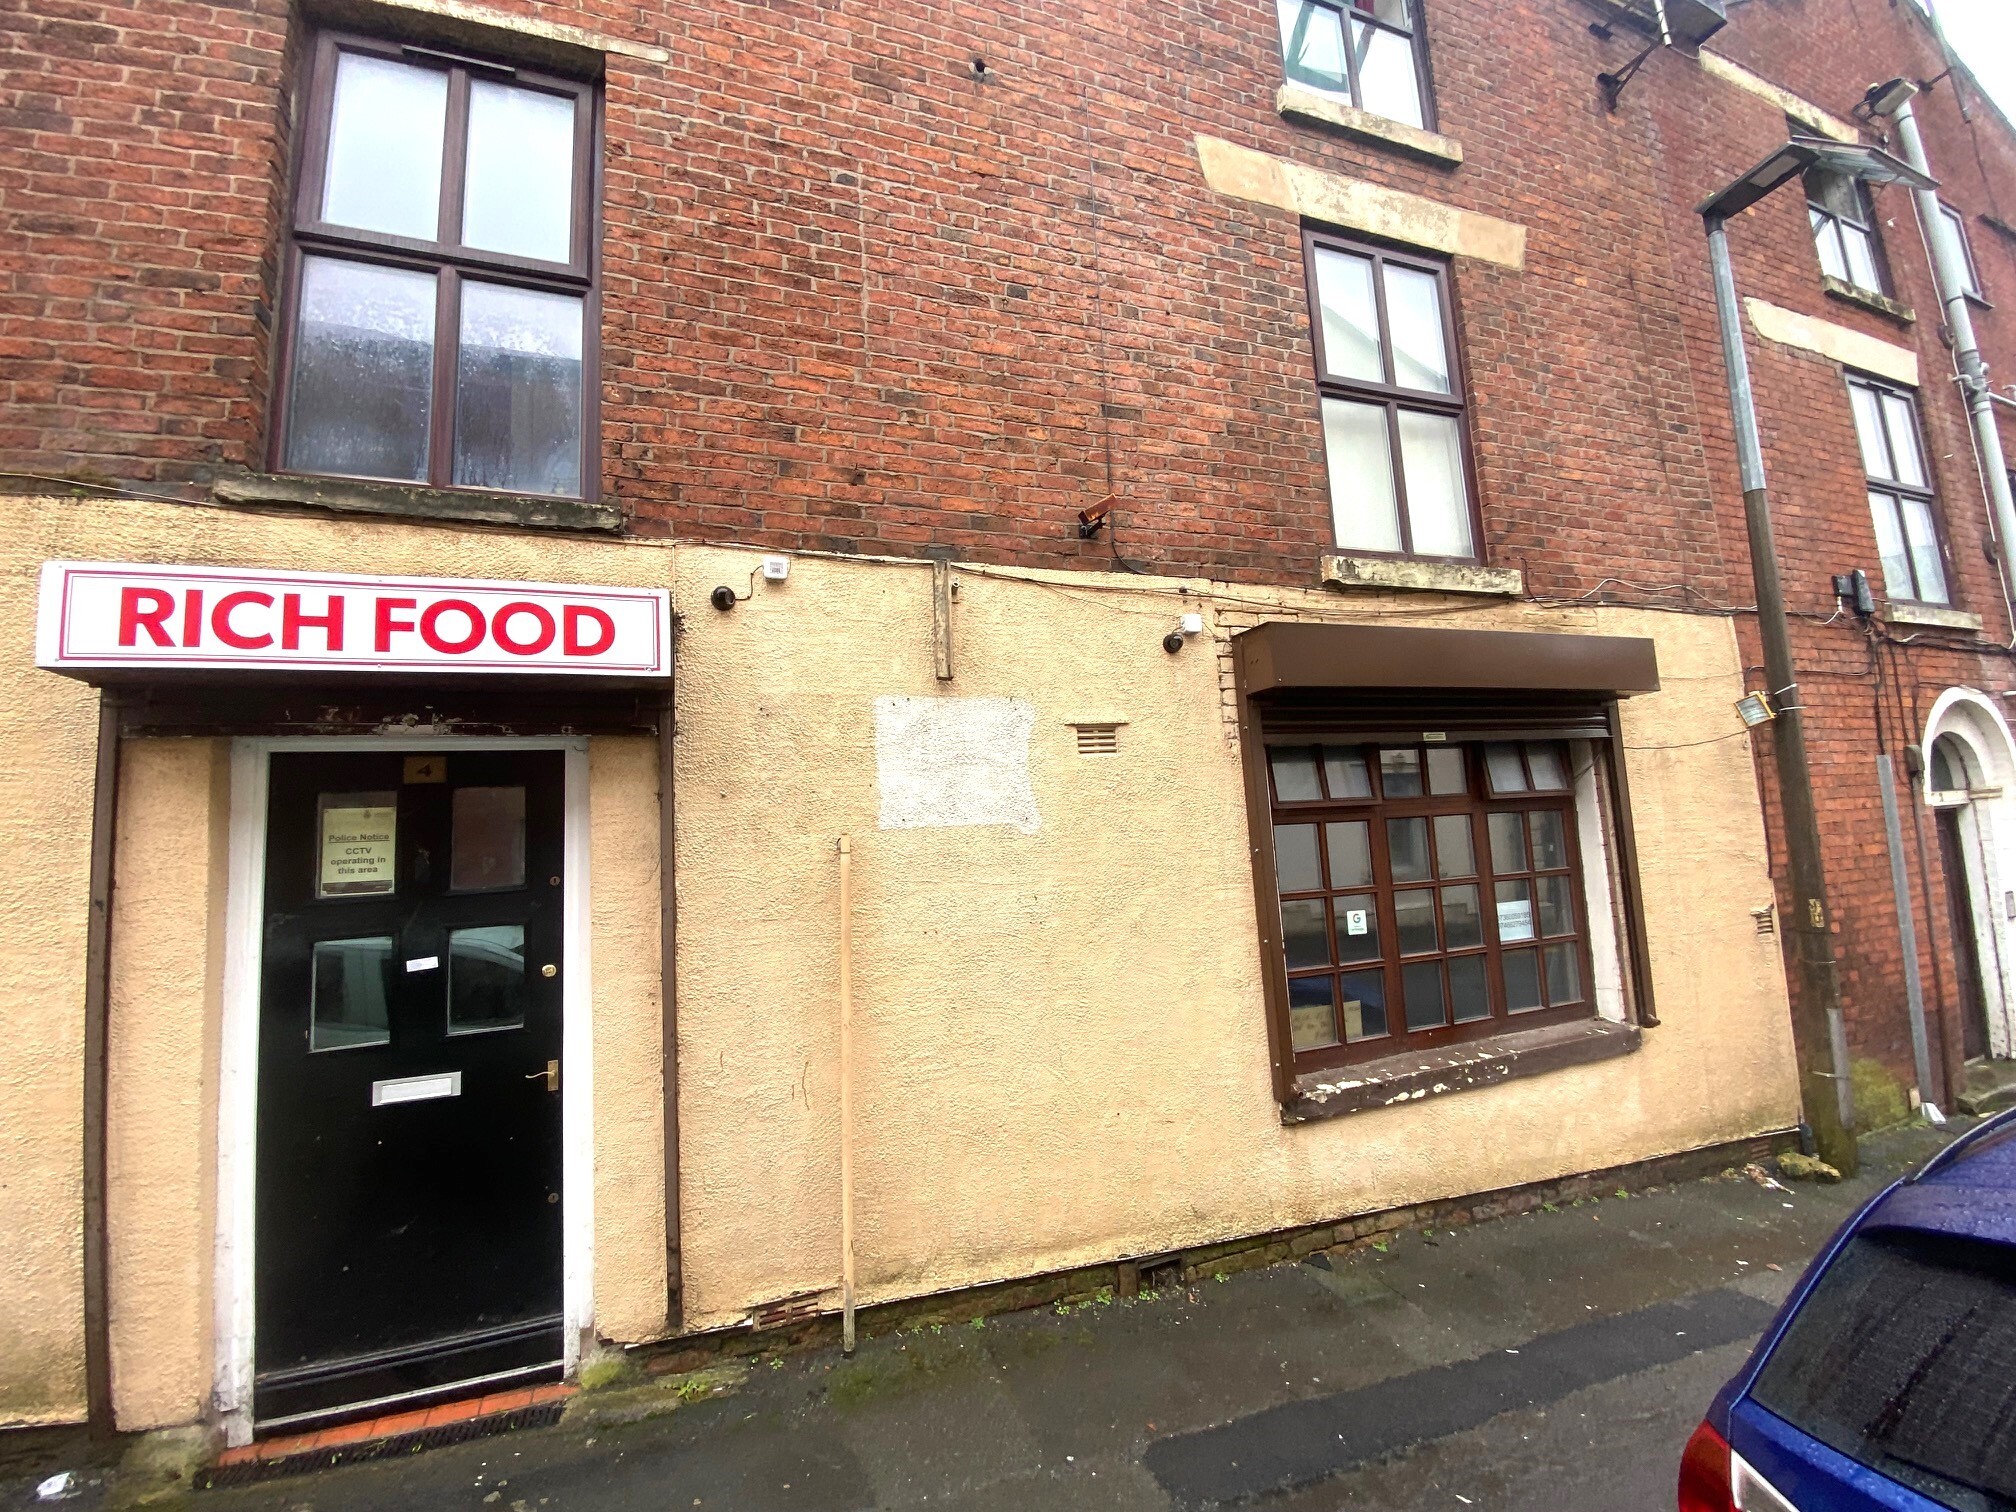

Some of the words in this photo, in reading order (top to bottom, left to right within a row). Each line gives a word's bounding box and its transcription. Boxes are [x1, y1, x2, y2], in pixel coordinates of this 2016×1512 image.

[117, 587, 345, 652] RICH
[374, 597, 616, 656] FOOD
[417, 761, 432, 777] 4
[328, 834, 358, 842] Police
[359, 833, 390, 841] Notice
[345, 847, 372, 855] CCTV
[330, 856, 375, 866] operating
[337, 866, 355, 874] this
[358, 866, 378, 874] area
[1352, 913, 1361, 924] G
